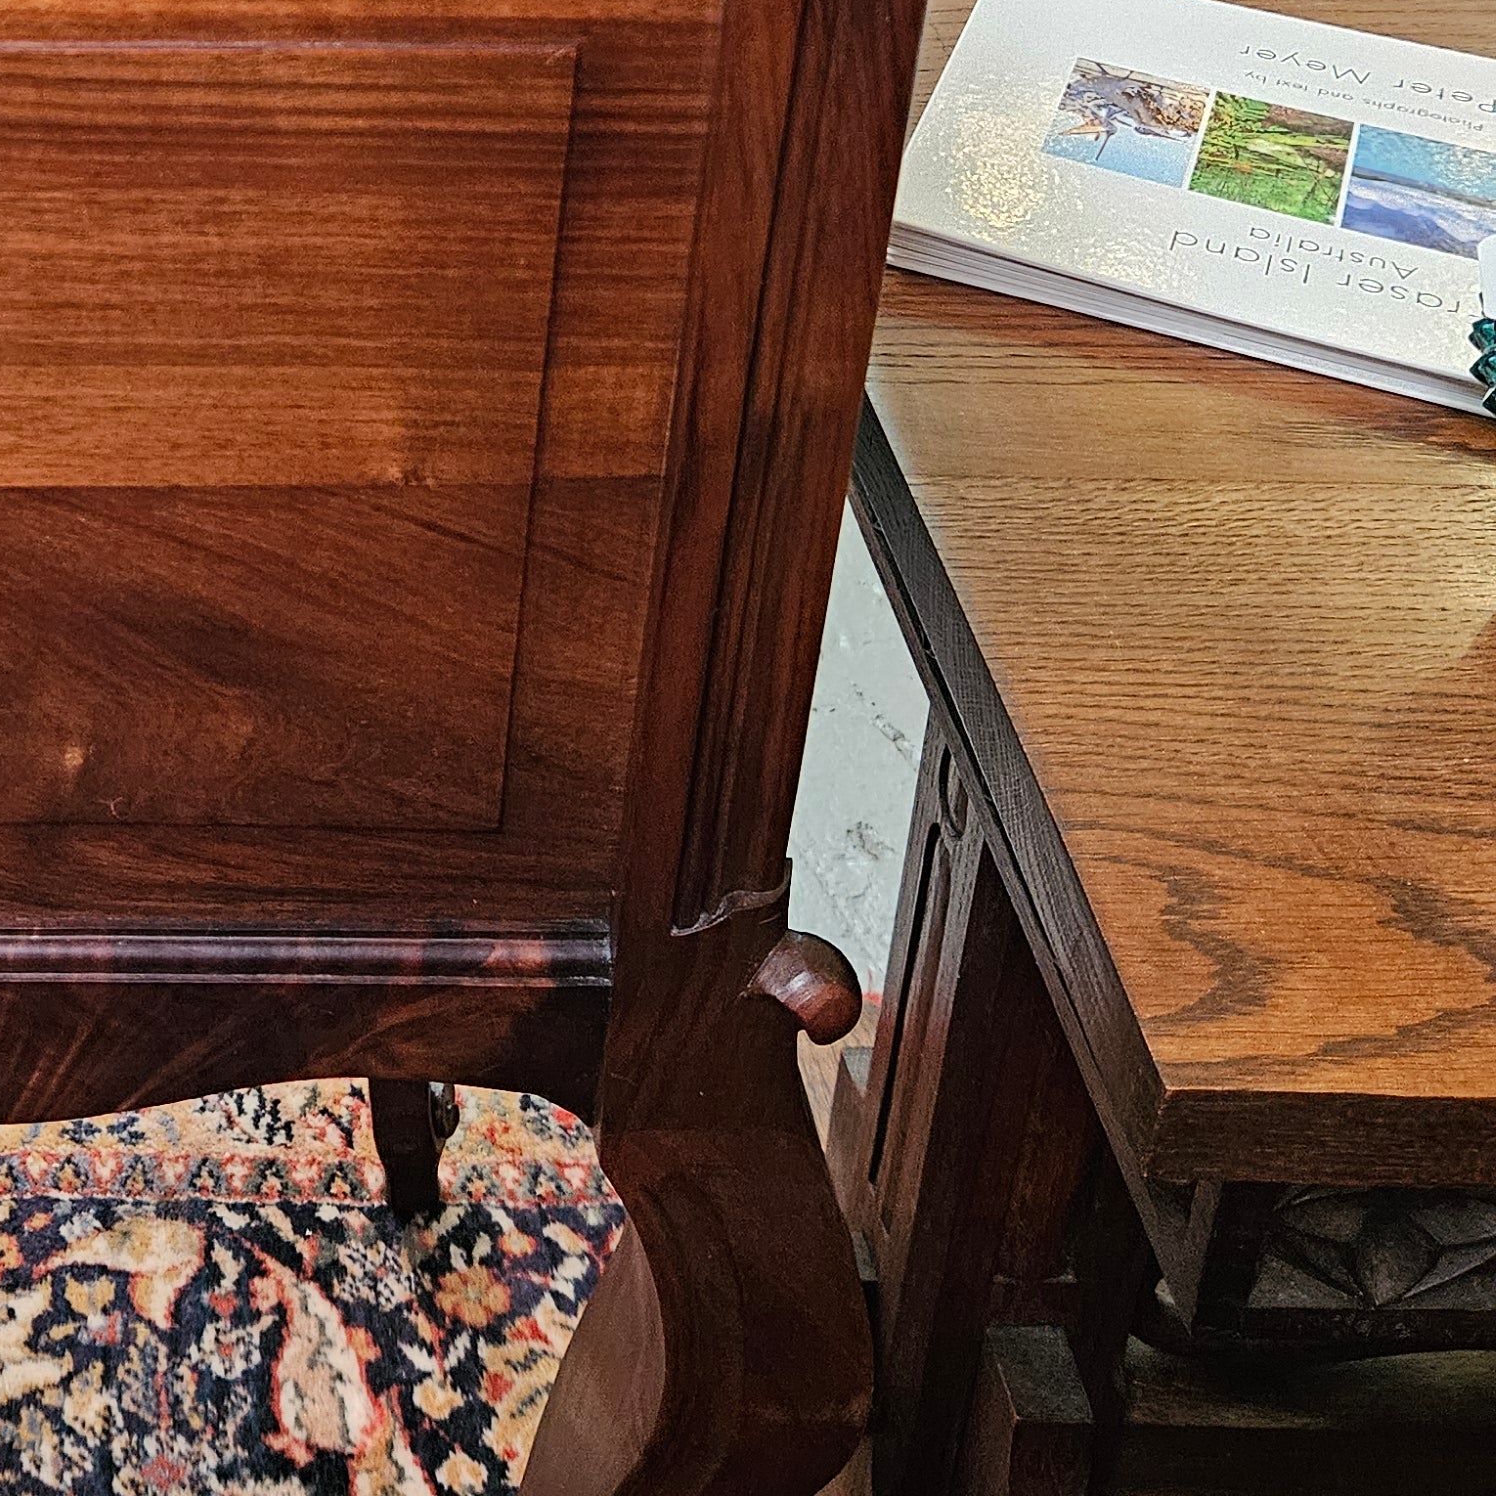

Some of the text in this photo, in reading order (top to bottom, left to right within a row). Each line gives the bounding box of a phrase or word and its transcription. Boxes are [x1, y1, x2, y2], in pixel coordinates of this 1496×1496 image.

[1240, 45, 1496, 114] Peter Meyer
[1244, 71, 1484, 132] Photographs and text by
[1169, 230, 1479, 317] raser Island
[1250, 227, 1419, 279] Australia
